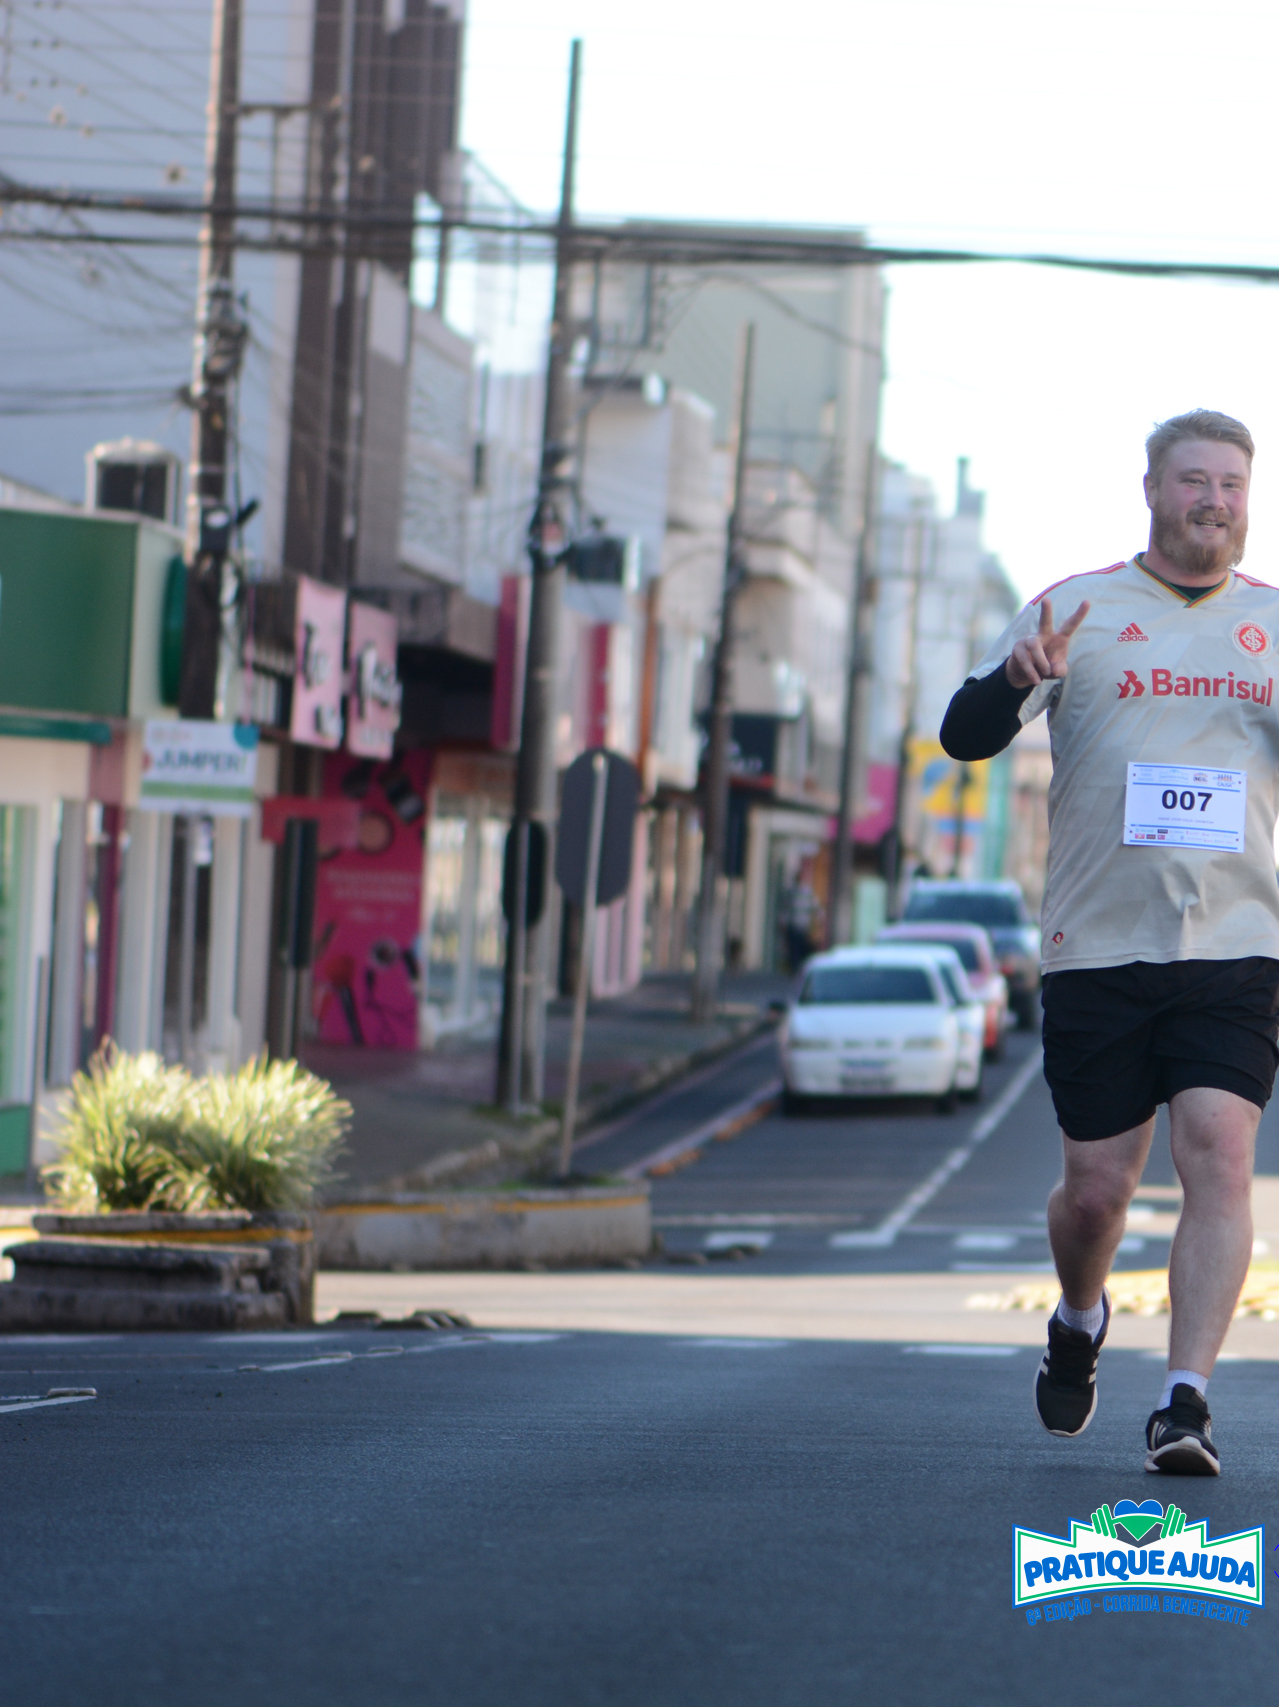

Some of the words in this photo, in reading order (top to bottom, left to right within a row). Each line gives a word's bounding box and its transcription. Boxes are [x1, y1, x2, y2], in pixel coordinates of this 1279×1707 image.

[1117, 634, 1149, 642] adidas
[1151, 668, 1274, 707] Banrisul
[1161, 789, 1213, 812] 007
